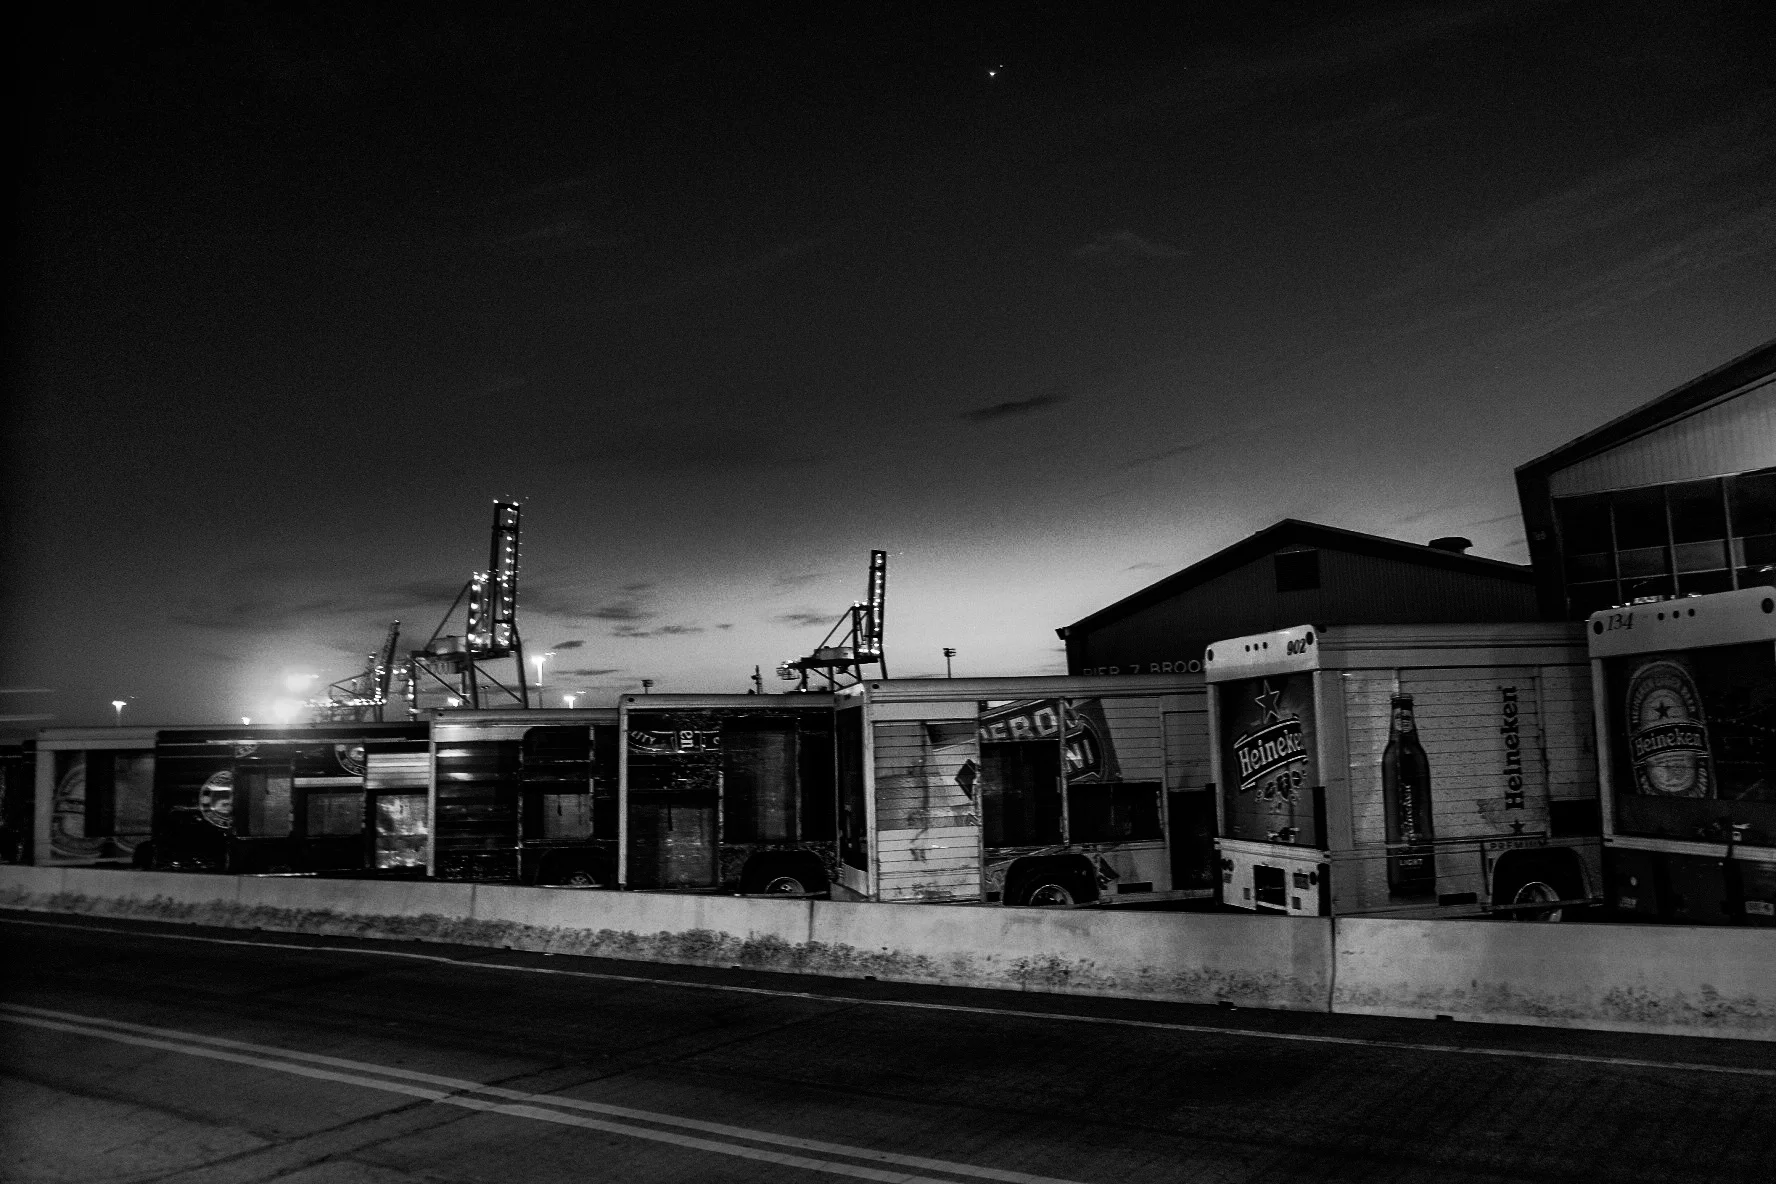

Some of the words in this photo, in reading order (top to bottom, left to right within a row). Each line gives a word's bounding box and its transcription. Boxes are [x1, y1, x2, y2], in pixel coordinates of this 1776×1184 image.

[1607, 613, 1633, 631] 134
[1287, 638, 1306, 656] 902
[1150, 660, 1205, 673] BROO
[1500, 686, 1524, 810] Heineken
[1634, 727, 1703, 756] Heineken
